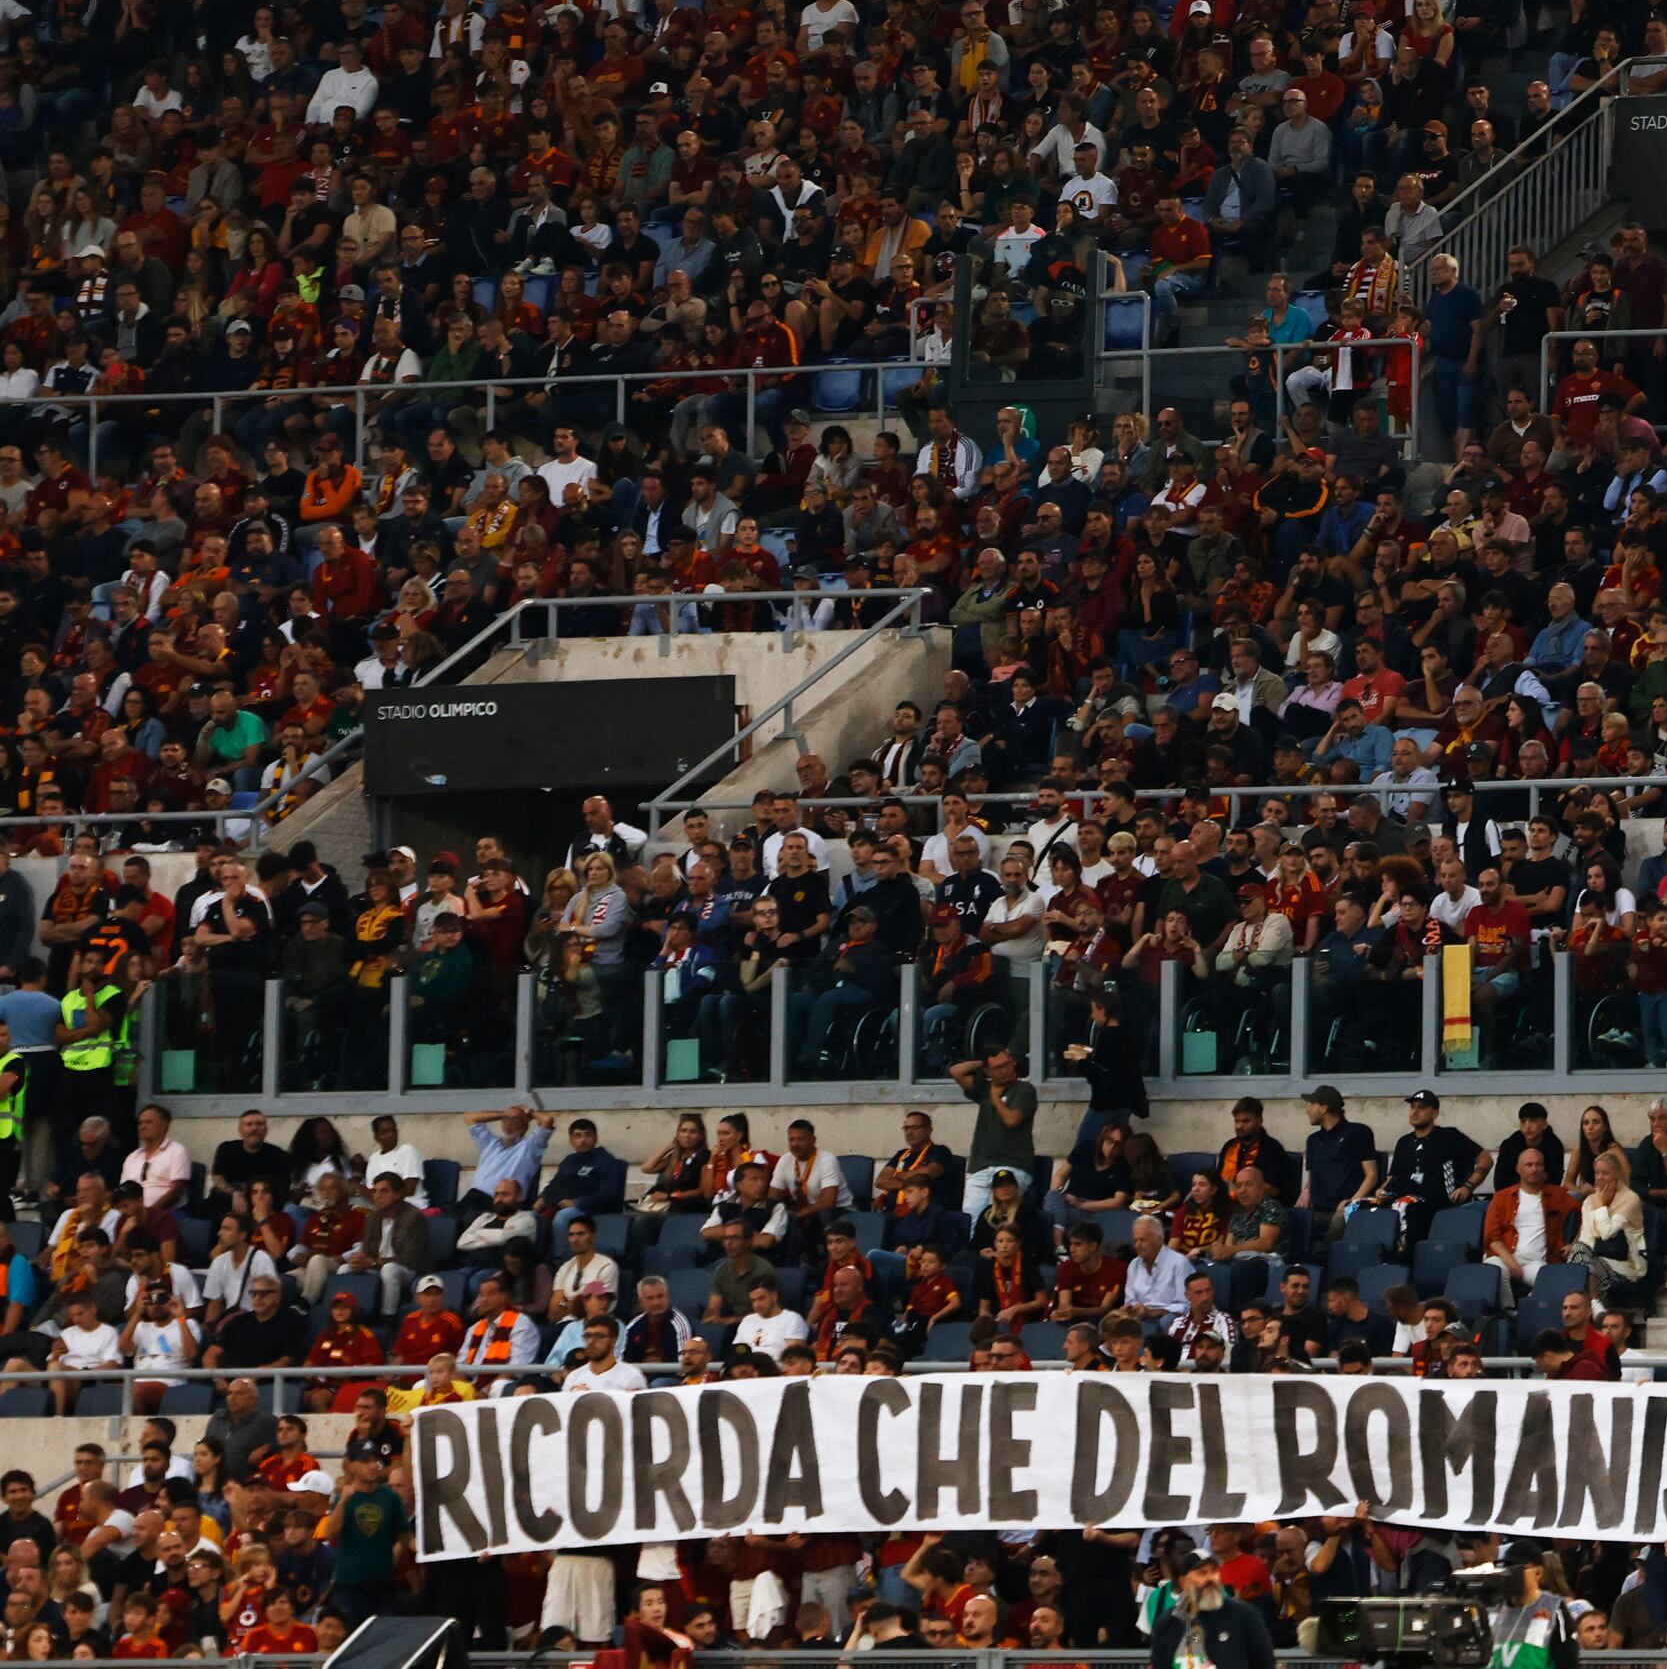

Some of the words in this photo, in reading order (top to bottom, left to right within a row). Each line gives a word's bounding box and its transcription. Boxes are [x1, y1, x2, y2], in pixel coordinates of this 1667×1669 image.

[377, 704, 427, 721] STADIO
[429, 701, 497, 719] OLIMPICO
[950, 902, 977, 916] SA
[417, 1380, 823, 1556] RICORDA
[858, 1379, 1038, 1525] CHE
[1071, 1381, 1245, 1525] DEL
